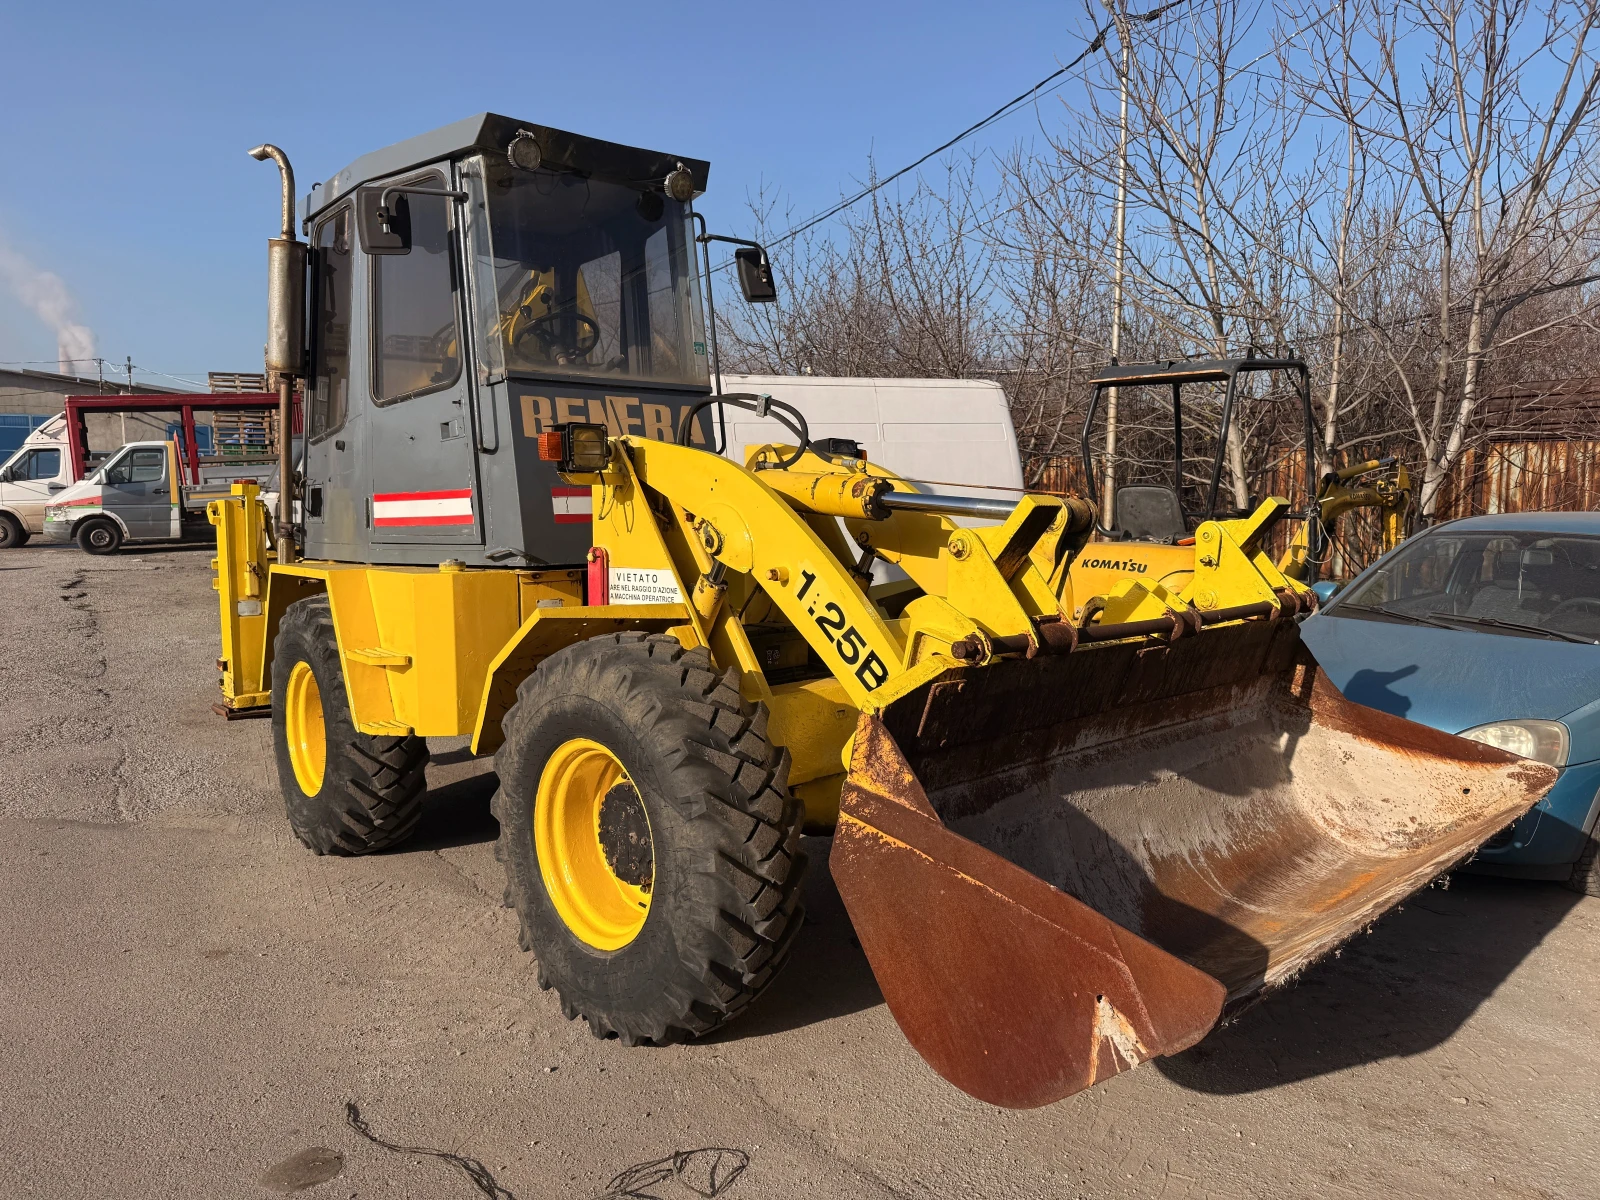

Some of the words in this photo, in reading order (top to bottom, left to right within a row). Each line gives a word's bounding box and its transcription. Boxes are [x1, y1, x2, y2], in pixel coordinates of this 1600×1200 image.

[1081, 559, 1148, 573] KOMATSU
[616, 572, 658, 583] VIETATO
[631, 585, 652, 593] RAGGIO
[653, 586, 678, 595] D'AZIONE
[614, 592, 640, 600] MACCHINA
[641, 594, 675, 603] OPERATRICE
